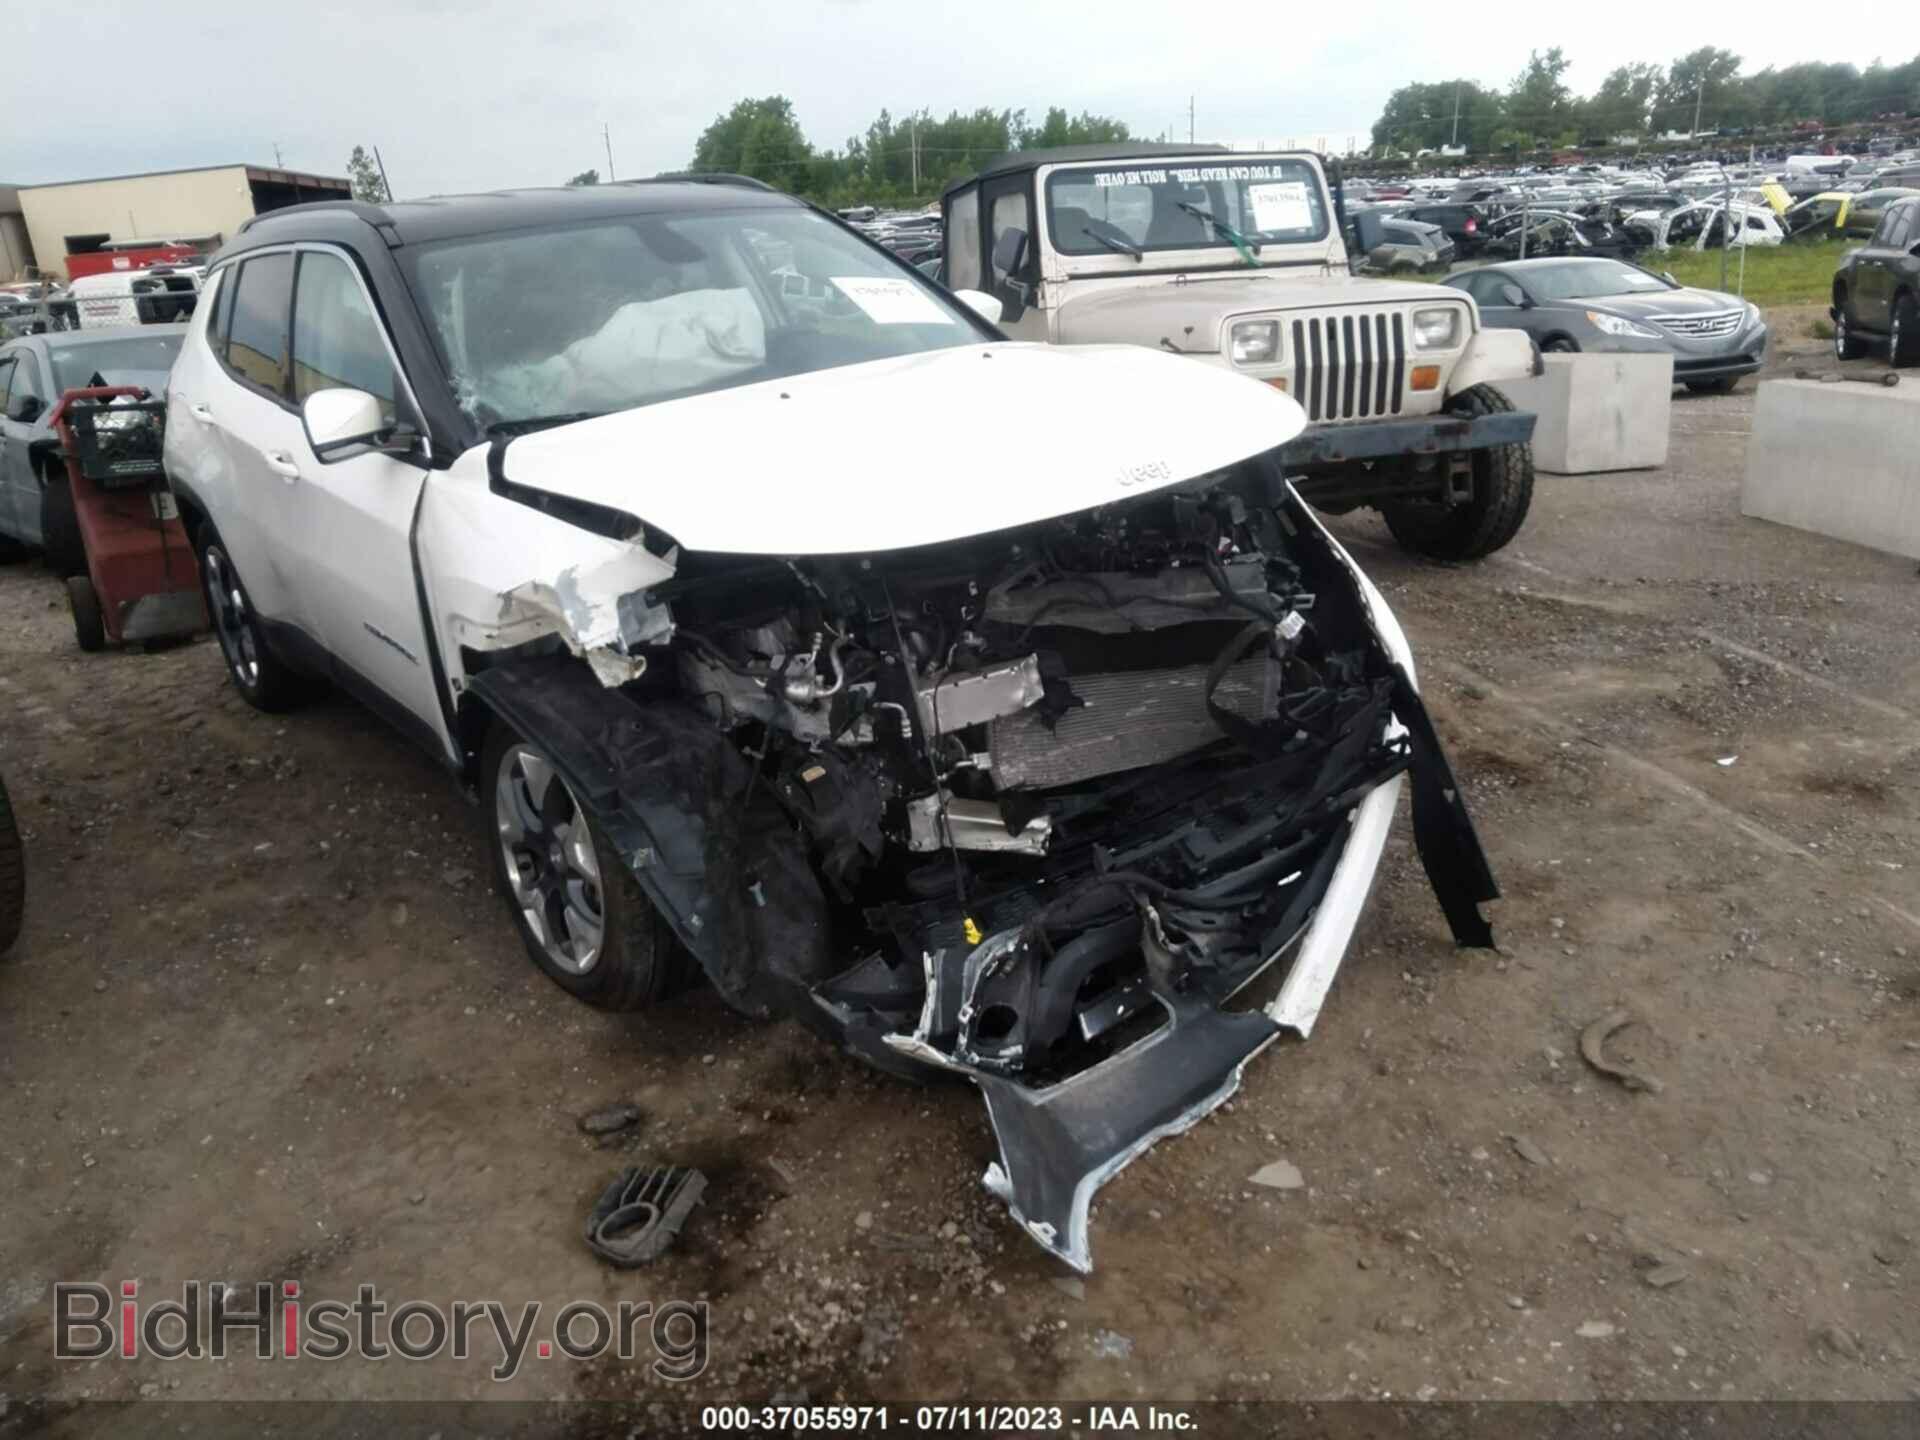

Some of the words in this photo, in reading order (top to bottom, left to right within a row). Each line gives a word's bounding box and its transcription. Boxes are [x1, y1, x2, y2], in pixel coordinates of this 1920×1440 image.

[1125, 170, 1141, 185] ME
[1140, 169, 1167, 184] ROLL
[1200, 167, 1228, 181] READ
[1229, 166, 1250, 180] CAN
[1250, 165, 1272, 180] YOU
[1272, 165, 1282, 179] IF
[1115, 460, 1171, 487] Jeep
